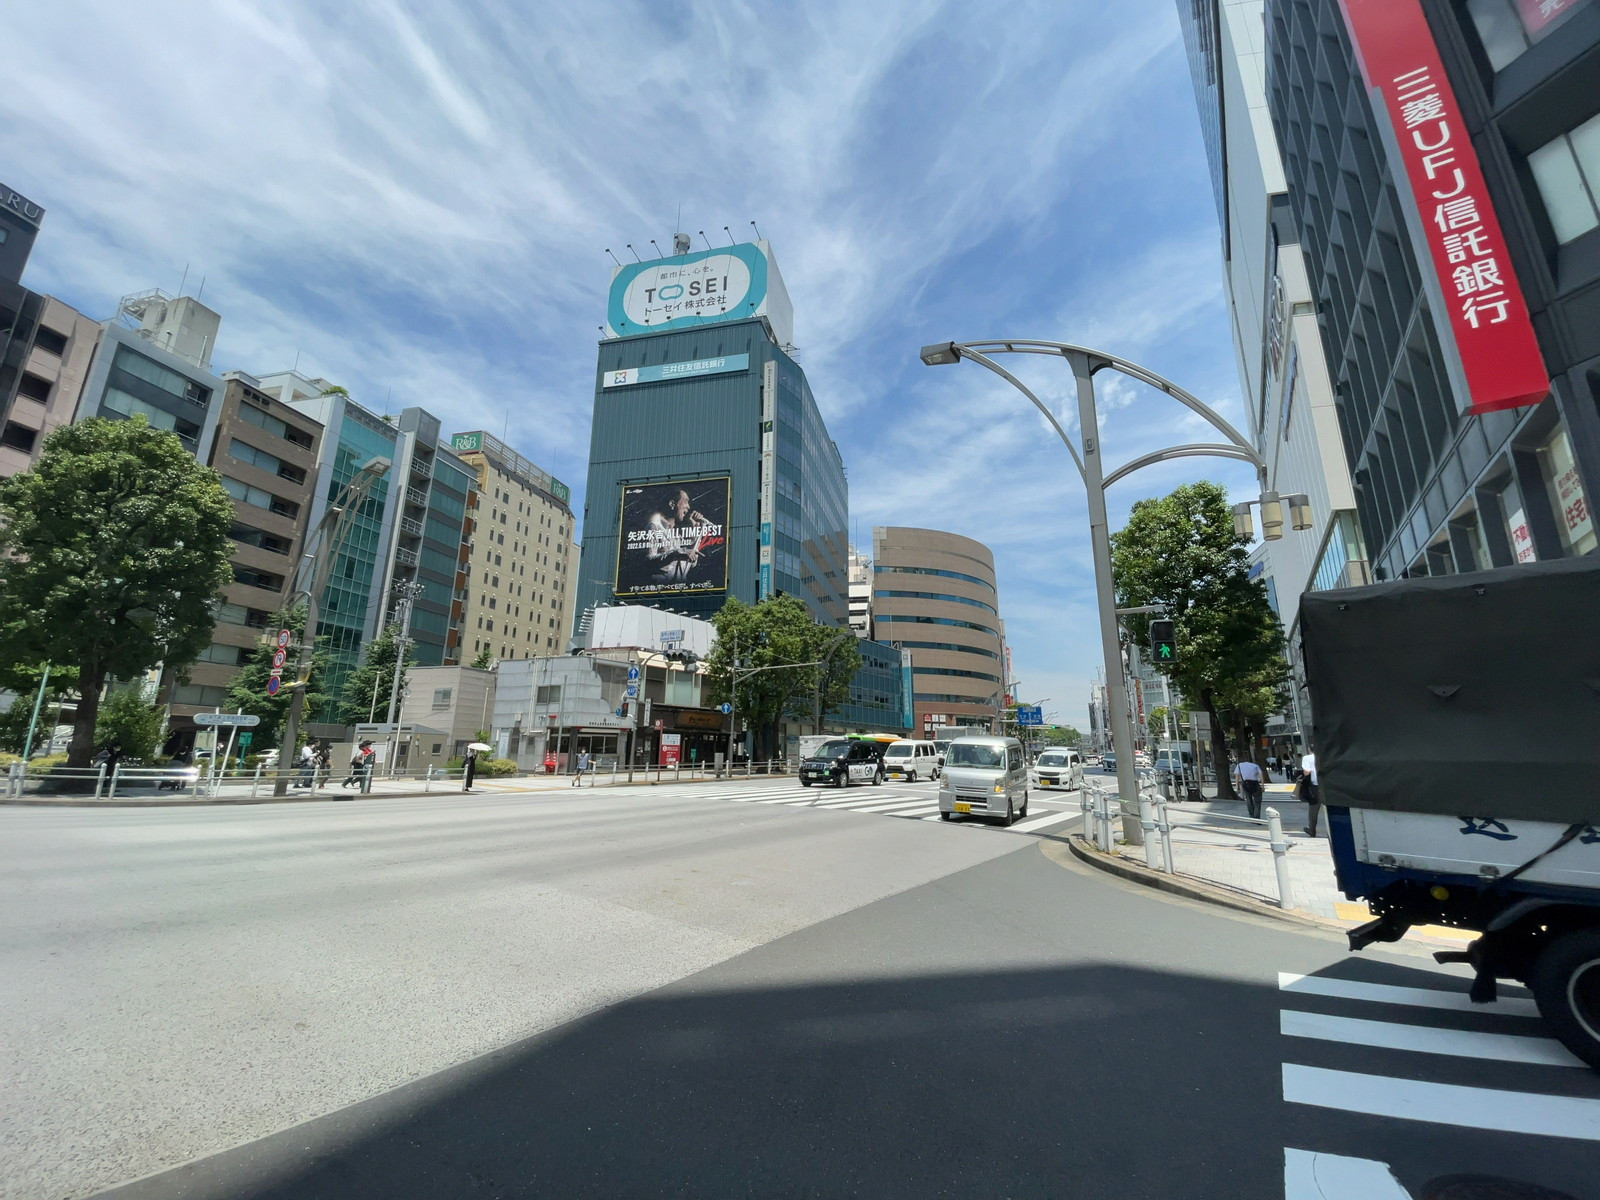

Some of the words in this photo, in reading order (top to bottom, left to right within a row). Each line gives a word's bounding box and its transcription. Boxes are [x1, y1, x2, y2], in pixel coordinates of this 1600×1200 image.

[0, 191, 40, 218] RU
[1393, 66, 1509, 328] 三菱UFJ信託銀行
[644, 275, 728, 304] TOSEI
[455, 436, 477, 450] R&B
[627, 530, 664, 542] 矢沢永吉
[666, 528, 682, 539] ALL
[681, 526, 701, 538] TIME
[702, 525, 723, 537] BEST
[697, 535, 724, 551] Live
